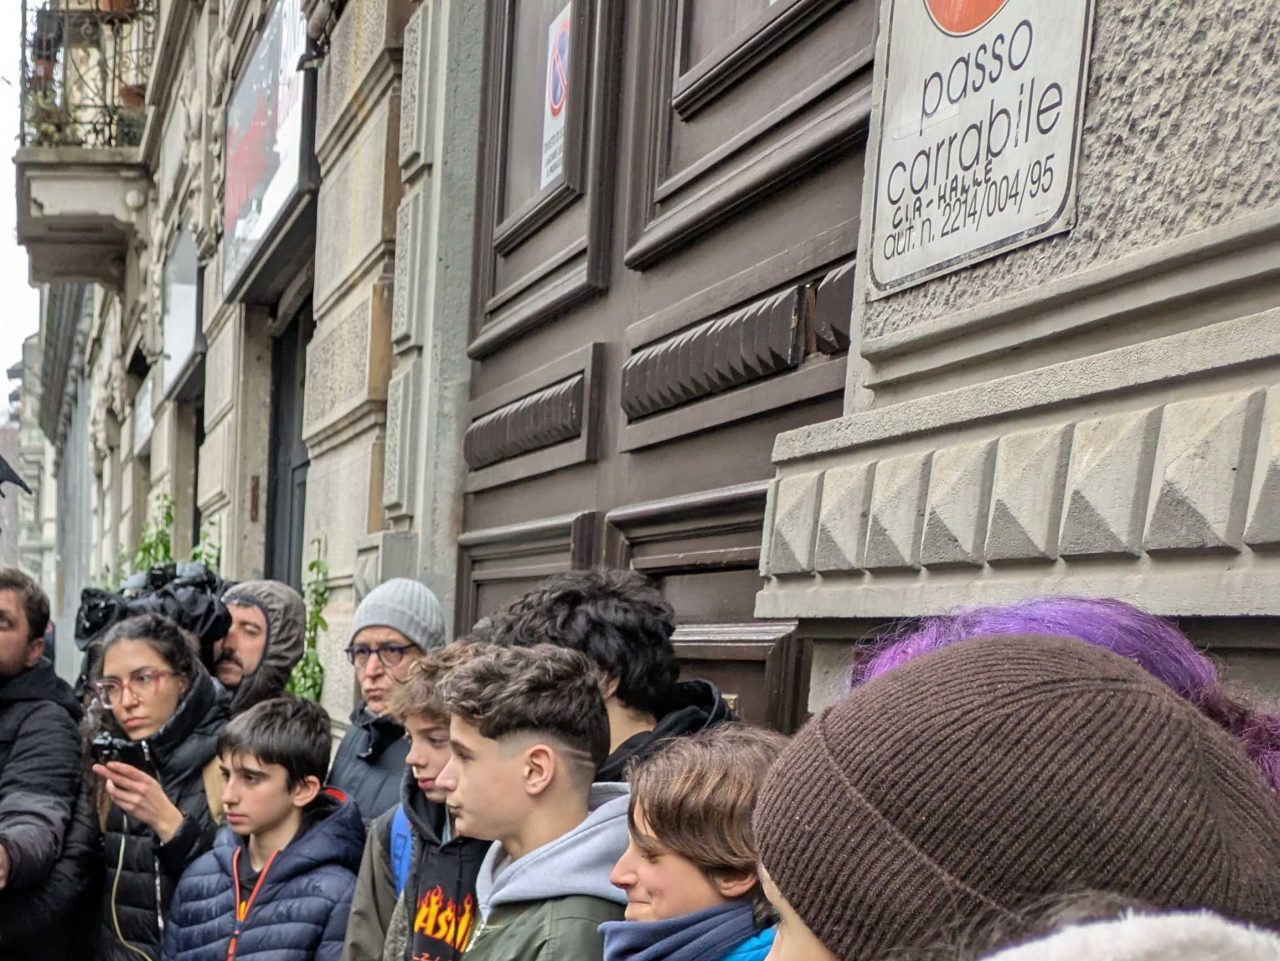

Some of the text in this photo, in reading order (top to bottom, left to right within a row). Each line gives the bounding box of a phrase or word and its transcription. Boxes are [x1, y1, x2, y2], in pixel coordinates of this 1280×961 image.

[920, 19, 1033, 136] passo
[887, 78, 1063, 205] carrabile
[883, 154, 1056, 260] aut. n. 2214/004/95
